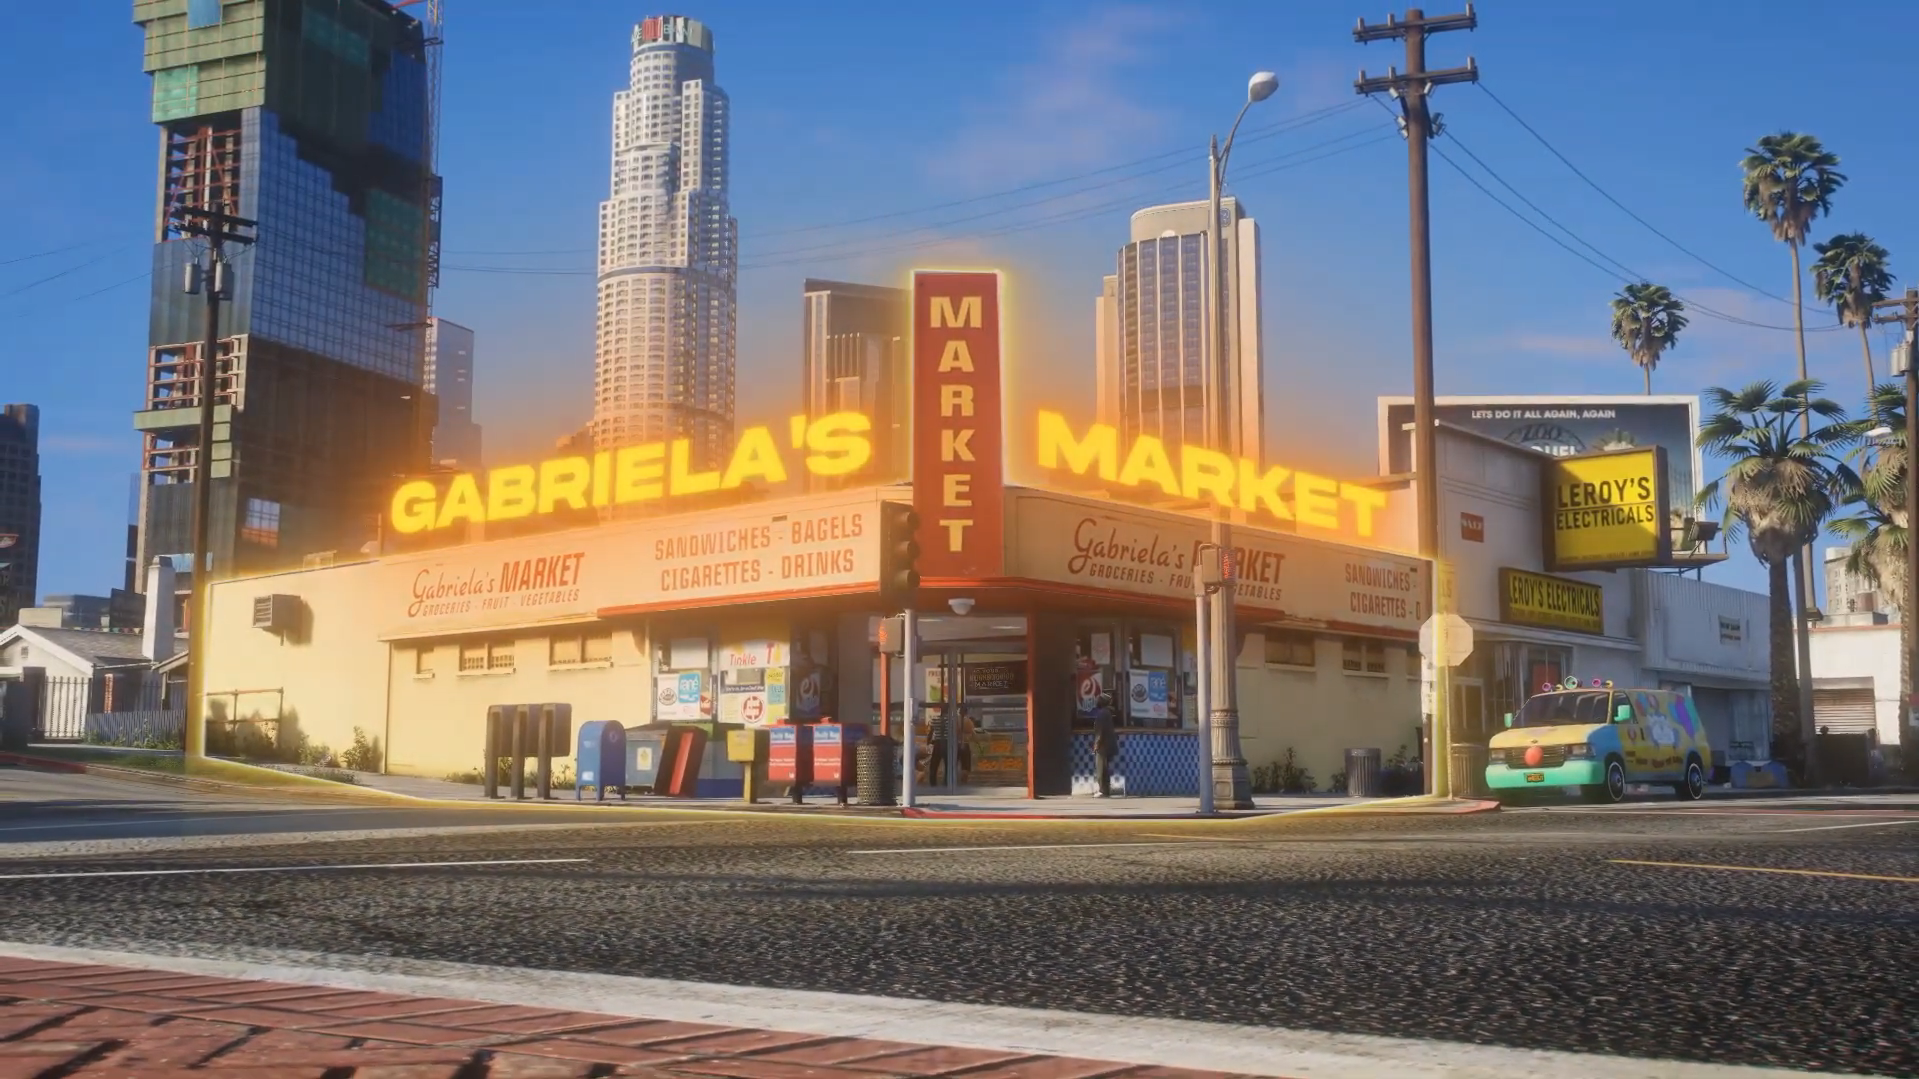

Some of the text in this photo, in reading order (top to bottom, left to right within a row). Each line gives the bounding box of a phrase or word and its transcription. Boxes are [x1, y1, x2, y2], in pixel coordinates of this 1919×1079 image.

[930, 296, 982, 552] MARKET
[1471, 410, 1493, 419] LETS
[1495, 410, 1511, 419] DO
[1513, 410, 1522, 419] IT
[1524, 410, 1542, 419] ALL
[1582, 409, 1616, 419] AGAIN
[391, 411, 872, 534] GABRIELA'S
[1037, 409, 1388, 538] MARKET
[1557, 476, 1651, 508] LEROY'S
[1556, 504, 1654, 531] ELECTRICALS
[655, 526, 771, 561] SANDWICHES
[791, 513, 863, 545] BAGELS
[1067, 518, 1286, 584] Gabriela's RKET
[408, 552, 586, 618] Gabriela's MARKET
[661, 559, 761, 592] CIGARETTES
[781, 548, 855, 580] DRINKS
[1089, 563, 1282, 601] GROCERIES FRU ETABLES
[1345, 563, 1411, 592] SANDWICHES
[422, 588, 580, 616] GROCERIES FRUIT VEGETABLES
[1350, 591, 1406, 618] CIGARETTES
[1546, 581, 1600, 617] ELECTRICALS
[730, 653, 757, 666] Tinkle
